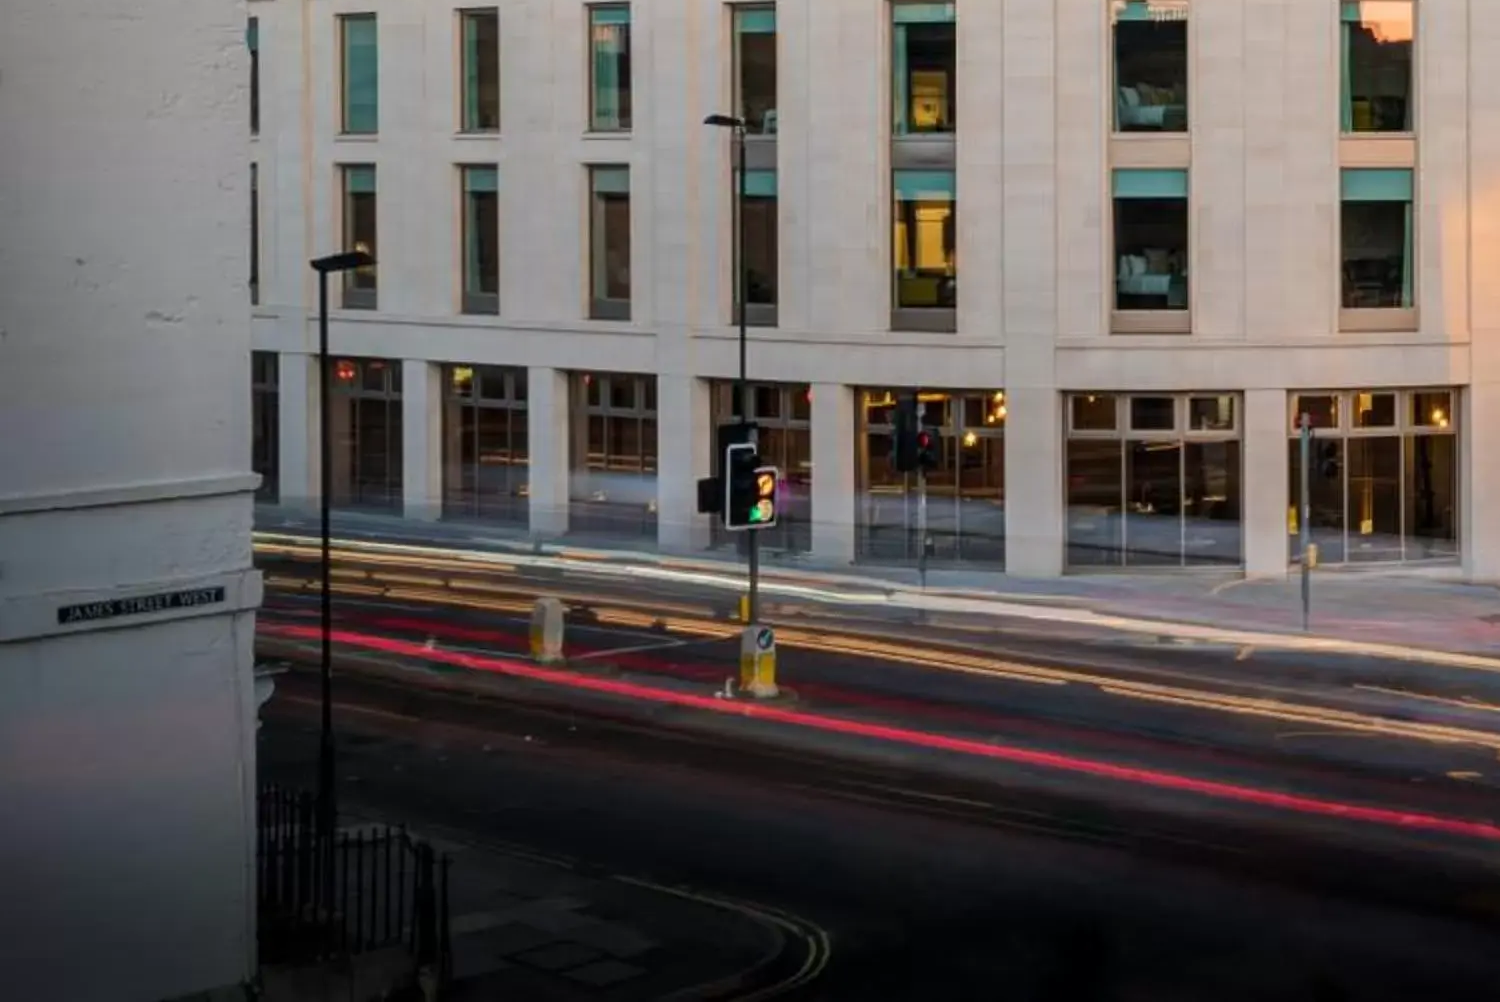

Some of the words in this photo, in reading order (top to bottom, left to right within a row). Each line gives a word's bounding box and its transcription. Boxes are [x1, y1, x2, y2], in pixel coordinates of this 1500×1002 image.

[69, 603, 114, 622] JAMES
[120, 595, 173, 614] STREET
[179, 589, 216, 607] WEST
